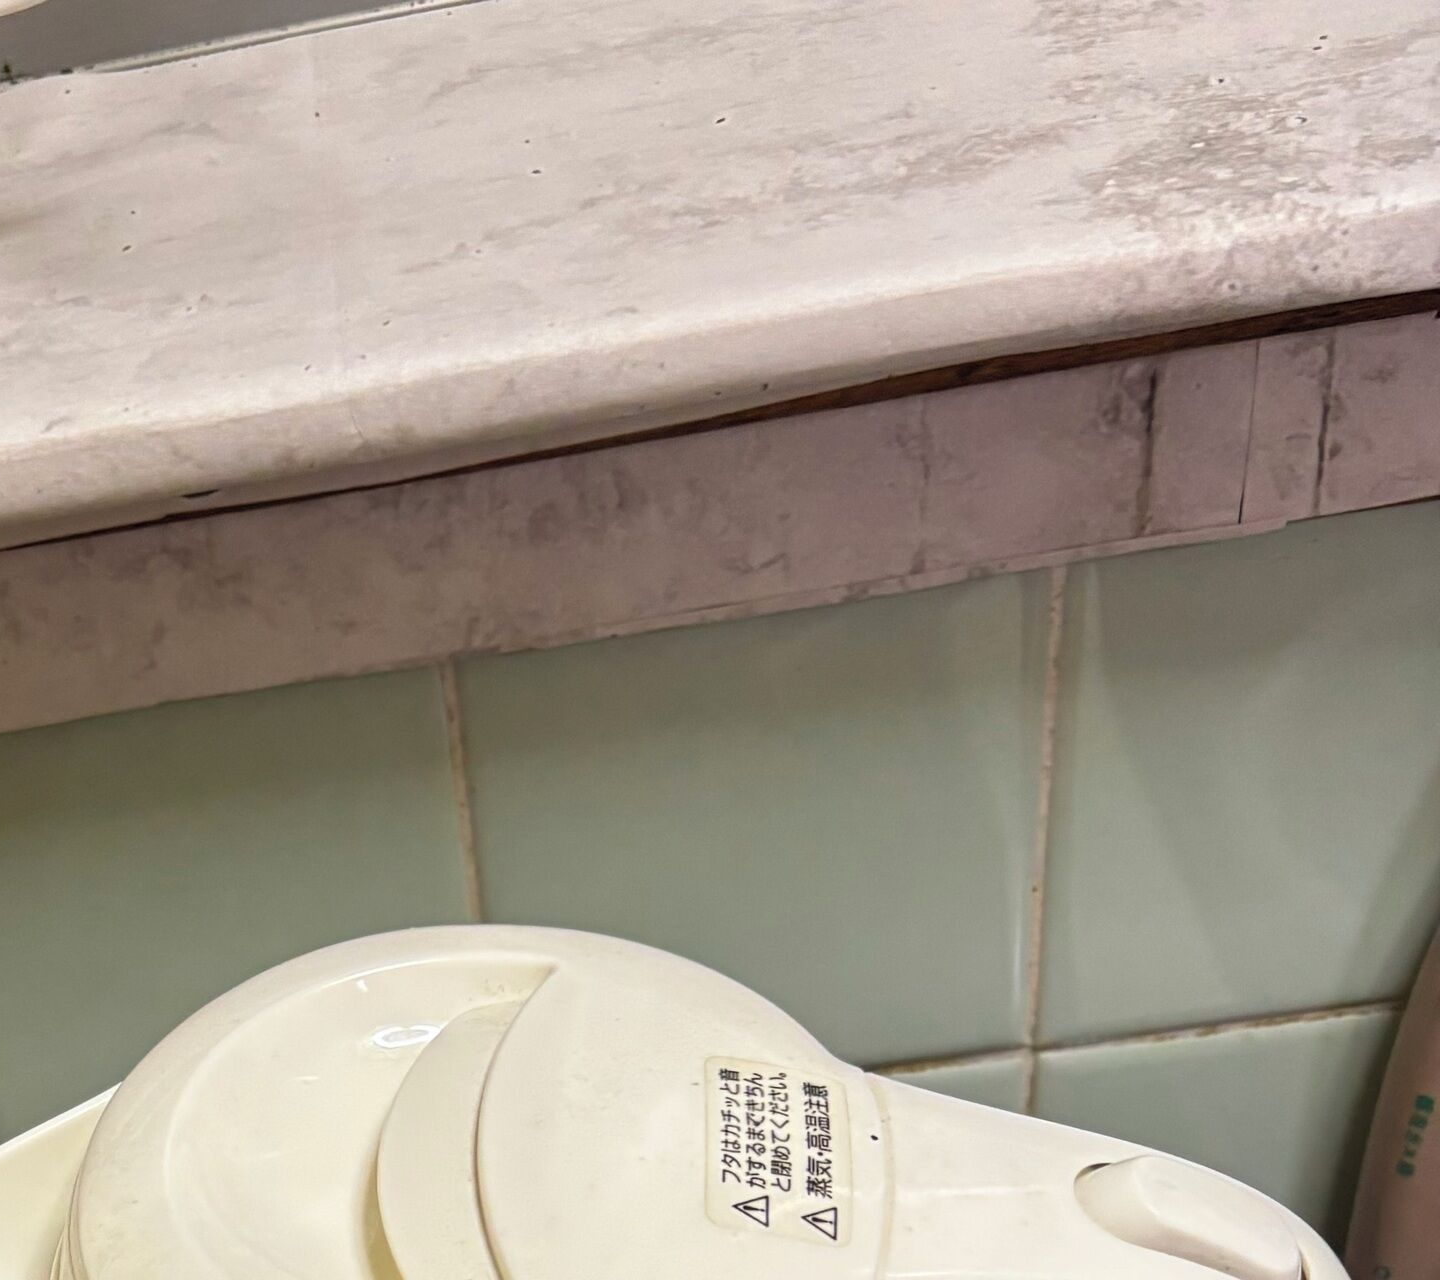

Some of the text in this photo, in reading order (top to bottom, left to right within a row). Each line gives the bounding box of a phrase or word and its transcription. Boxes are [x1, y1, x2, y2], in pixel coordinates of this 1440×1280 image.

[718, 1068, 742, 1184] フタはカチッと音
[743, 1073, 767, 1189] がするまできちん
[768, 1072, 792, 1193] と閉めてください。
[802, 1082, 833, 1200] 蒸気・高温注意
